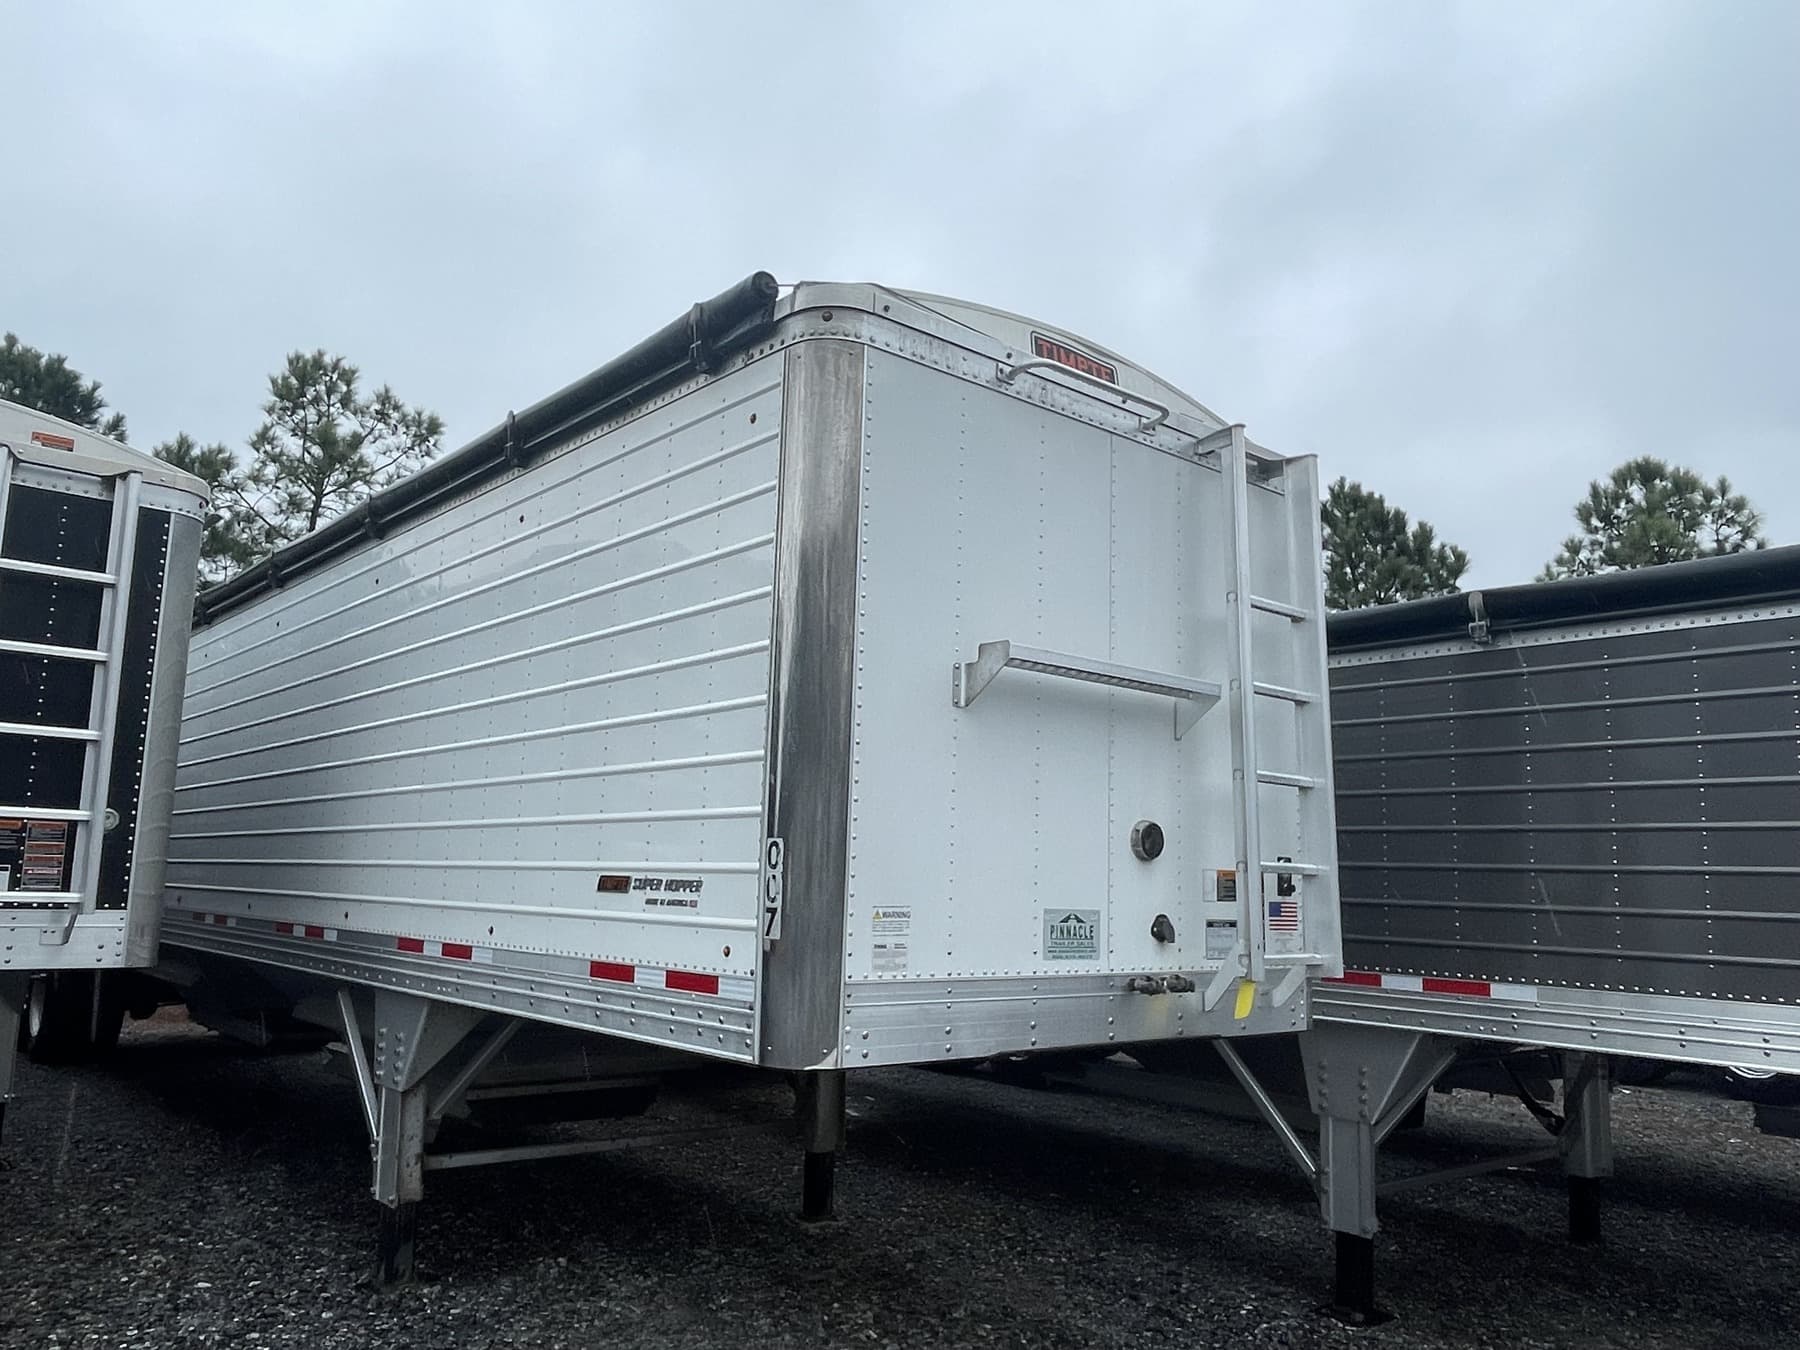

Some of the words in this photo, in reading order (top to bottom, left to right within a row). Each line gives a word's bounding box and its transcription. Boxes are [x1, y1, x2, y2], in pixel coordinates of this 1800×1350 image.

[1038, 338, 1112, 380] TIMPTE
[632, 878, 663, 891] SUPER
[664, 879, 703, 892] HOPPER
[882, 911, 911, 919] WARNING
[1050, 924, 1094, 939] PINNACLE
